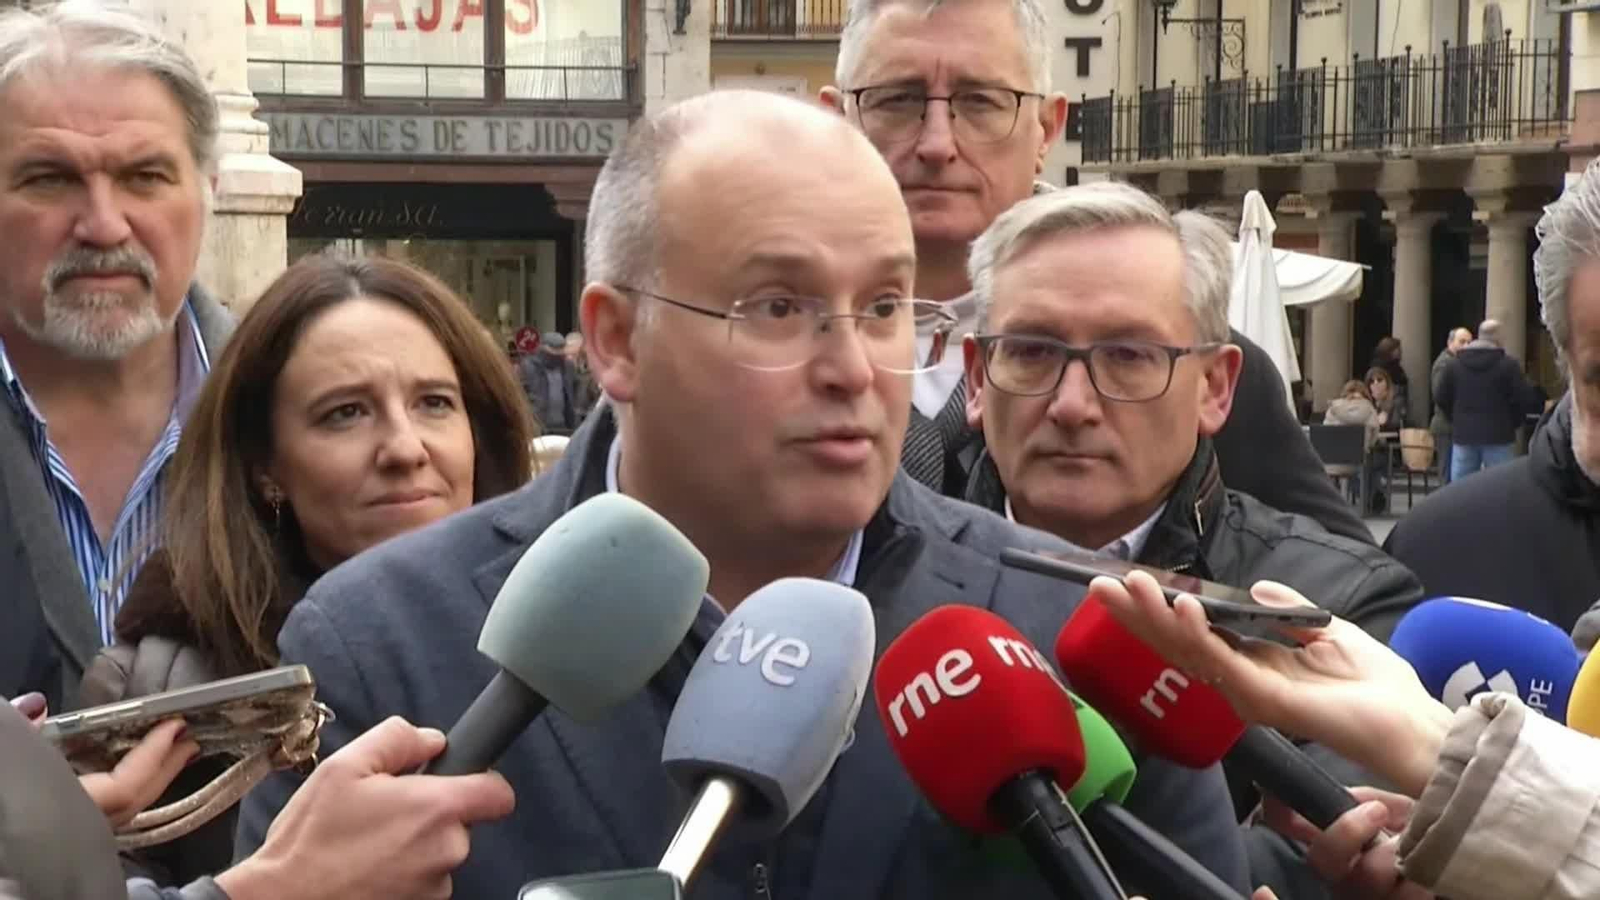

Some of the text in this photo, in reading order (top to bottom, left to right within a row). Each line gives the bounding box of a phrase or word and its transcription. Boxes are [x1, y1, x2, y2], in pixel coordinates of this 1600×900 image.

[433, 120, 467, 153] DE
[484, 122, 613, 154] TEJIDOS
[713, 621, 810, 686] tve
[888, 648, 982, 737] rne
[1527, 678, 1553, 715] PE
